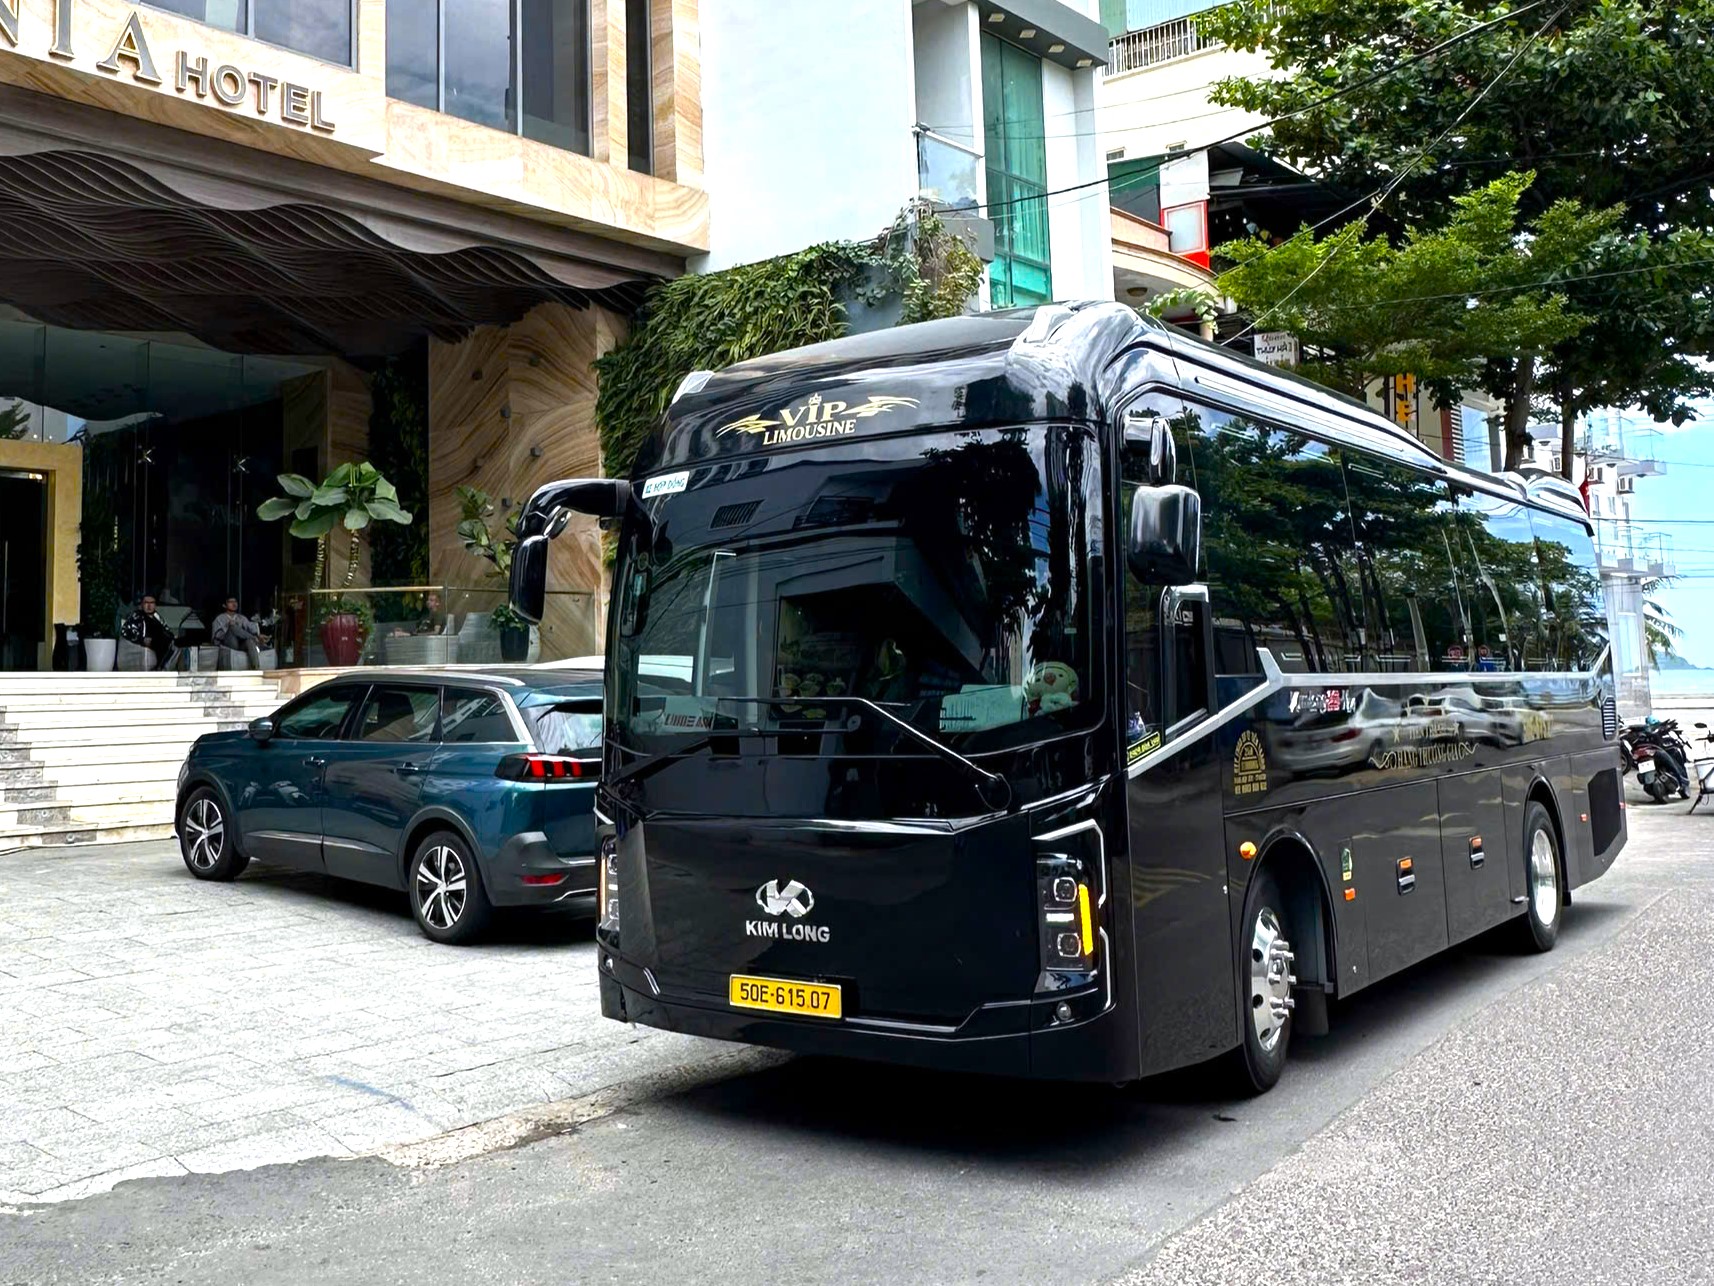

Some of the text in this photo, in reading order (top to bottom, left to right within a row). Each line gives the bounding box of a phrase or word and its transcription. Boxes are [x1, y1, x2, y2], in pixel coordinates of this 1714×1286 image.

[175, 51, 336, 132] HOTEL
[780, 401, 847, 426] VIP
[762, 419, 857, 446] LIMOUSINE
[745, 920, 831, 943] KIM LONG
